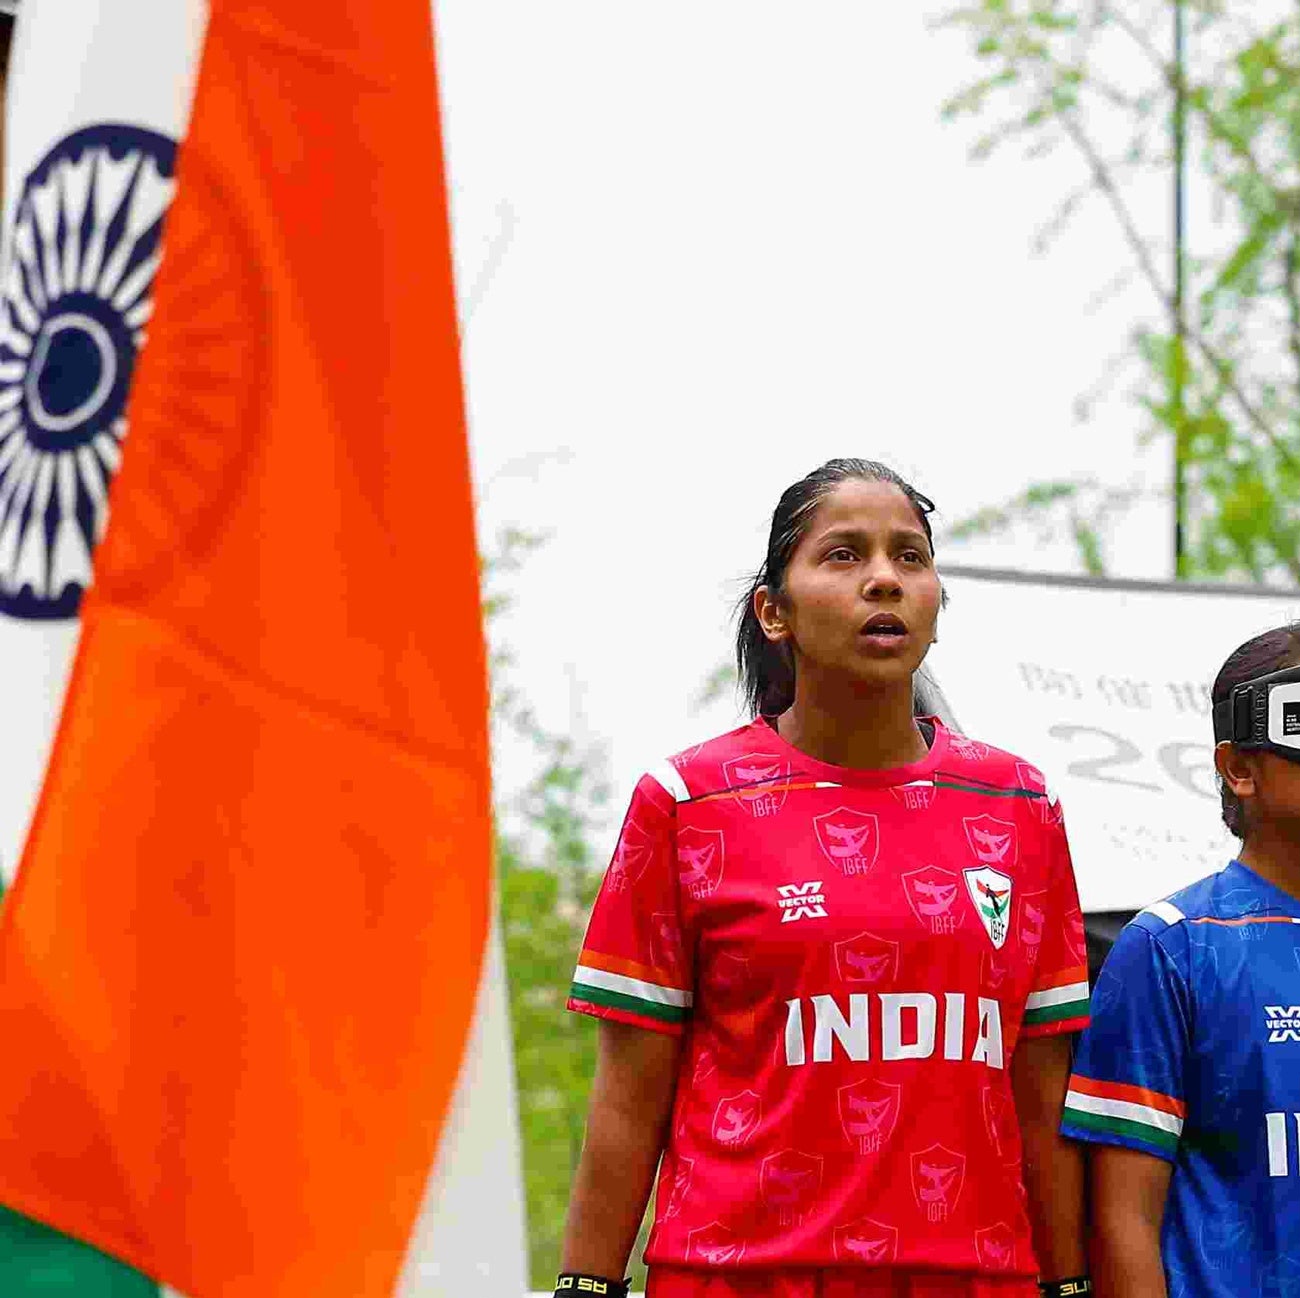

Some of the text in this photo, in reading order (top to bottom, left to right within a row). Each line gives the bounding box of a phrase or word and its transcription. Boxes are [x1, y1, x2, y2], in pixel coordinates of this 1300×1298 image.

[752, 798, 779, 818] IBFF
[904, 791, 930, 810] IBFF
[842, 857, 868, 877] IBFF
[777, 893, 825, 908] VECTOR
[930, 915, 956, 935] IBFF
[784, 992, 1004, 1070] INDIA
[1060, 1280, 1090, 1297] NE
